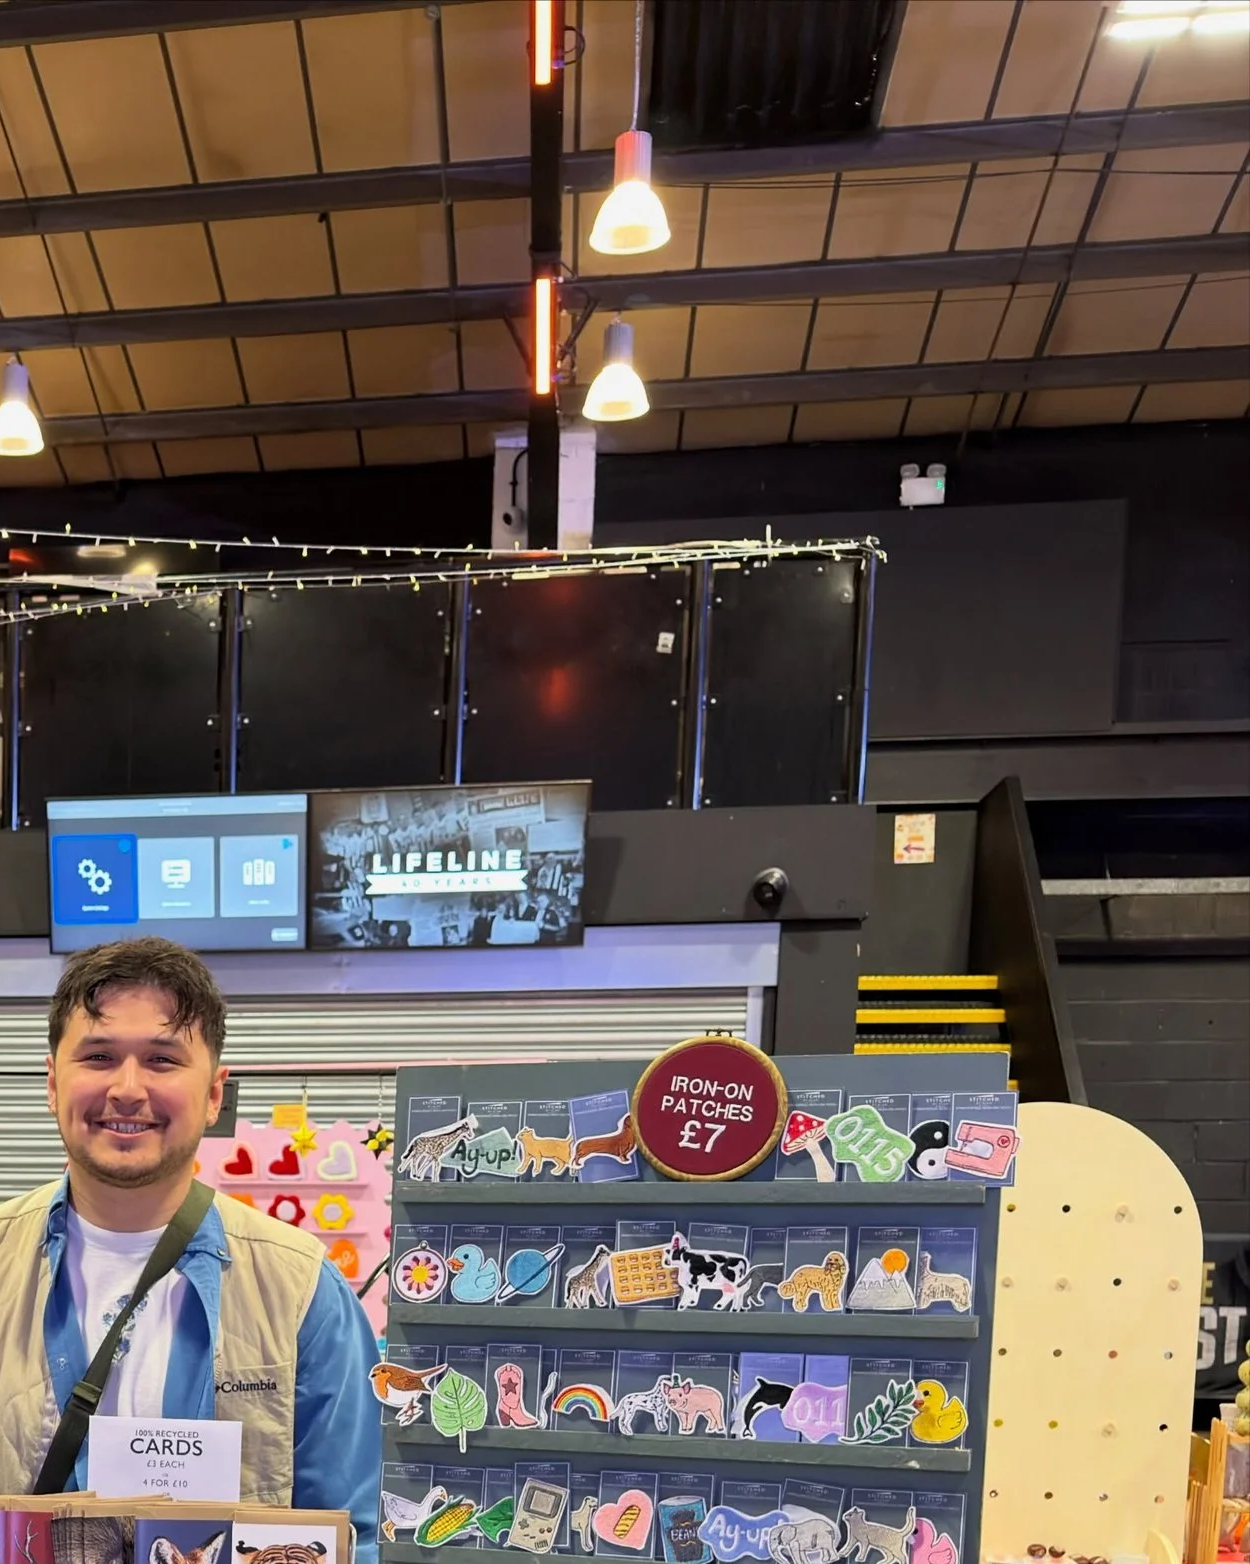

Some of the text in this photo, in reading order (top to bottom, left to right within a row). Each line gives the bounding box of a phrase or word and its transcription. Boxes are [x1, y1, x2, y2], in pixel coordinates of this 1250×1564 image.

[372, 850, 522, 874] LIFELINE
[434, 877, 492, 886] YEARS
[671, 1075, 754, 1101] IRON-ON
[661, 1095, 754, 1122] PATCHES
[678, 1120, 727, 1153] £7
[834, 1116, 904, 1176] 0115
[450, 1139, 519, 1175] Ay-up!
[220, 1378, 277, 1393] Columbia
[155, 1430, 199, 1439] RECYCLED
[130, 1438, 203, 1457] CARDS
[146, 1460, 185, 1469] £3 EACH
[143, 1479, 188, 1488] 4 FOR £10
